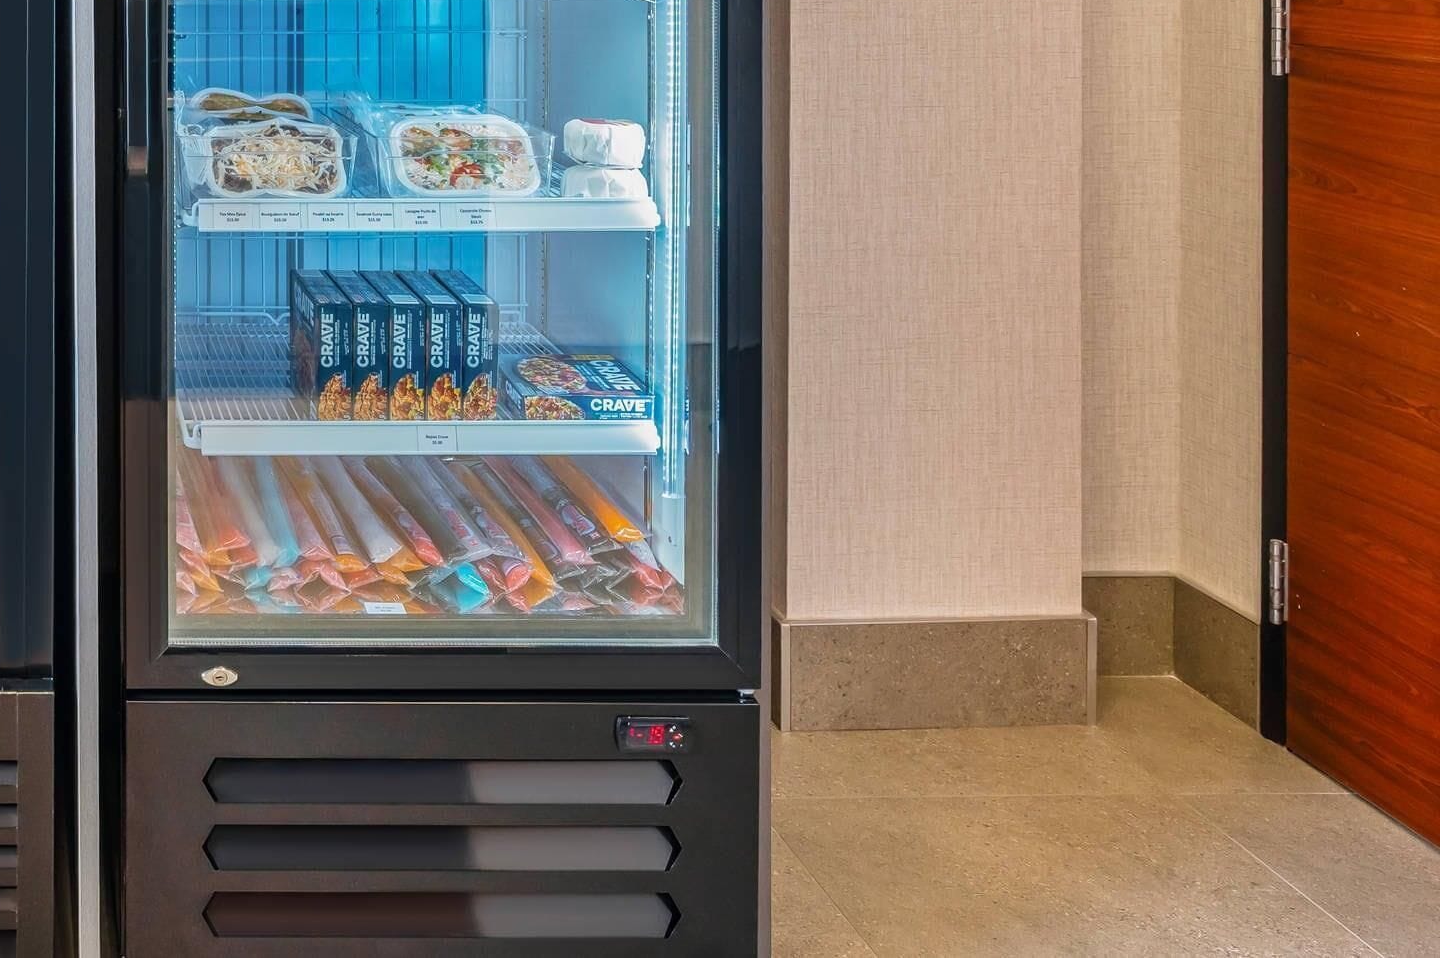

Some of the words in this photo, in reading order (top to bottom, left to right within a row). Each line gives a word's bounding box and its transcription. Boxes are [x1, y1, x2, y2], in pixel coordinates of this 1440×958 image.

[320, 312, 334, 368] CRAVE
[356, 312, 370, 368] CRAVE
[392, 313, 406, 369] CRAVE
[430, 313, 444, 368] CRAVE
[466, 312, 481, 368] CRAVE
[589, 359, 641, 392] CRAVE
[590, 398, 646, 412] CRAVE
